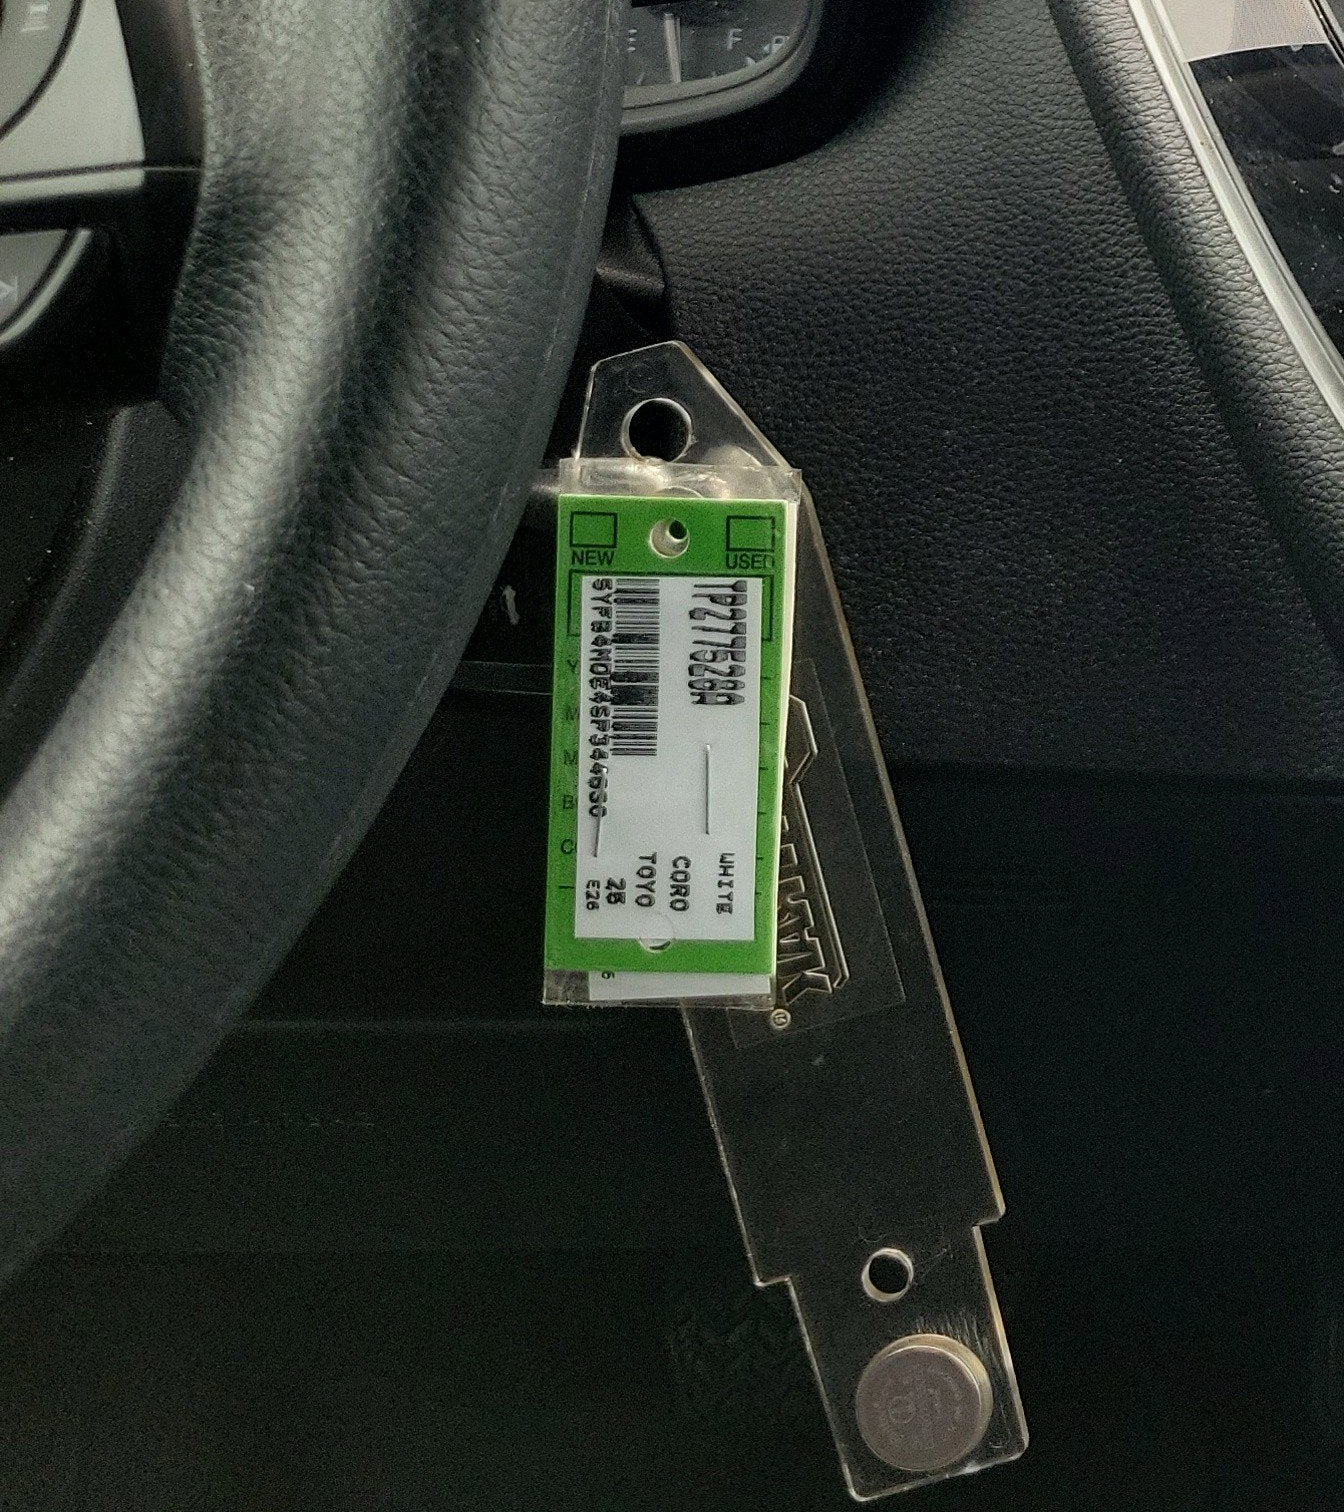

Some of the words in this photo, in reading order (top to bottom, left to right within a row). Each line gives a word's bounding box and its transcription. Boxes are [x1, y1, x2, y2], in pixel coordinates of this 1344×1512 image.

[571, 550, 615, 566] NEW
[726, 552, 775, 570] USED
[635, 852, 657, 907] TOYO
[669, 856, 692, 912] CORO
[716, 853, 735, 914] WHITE
